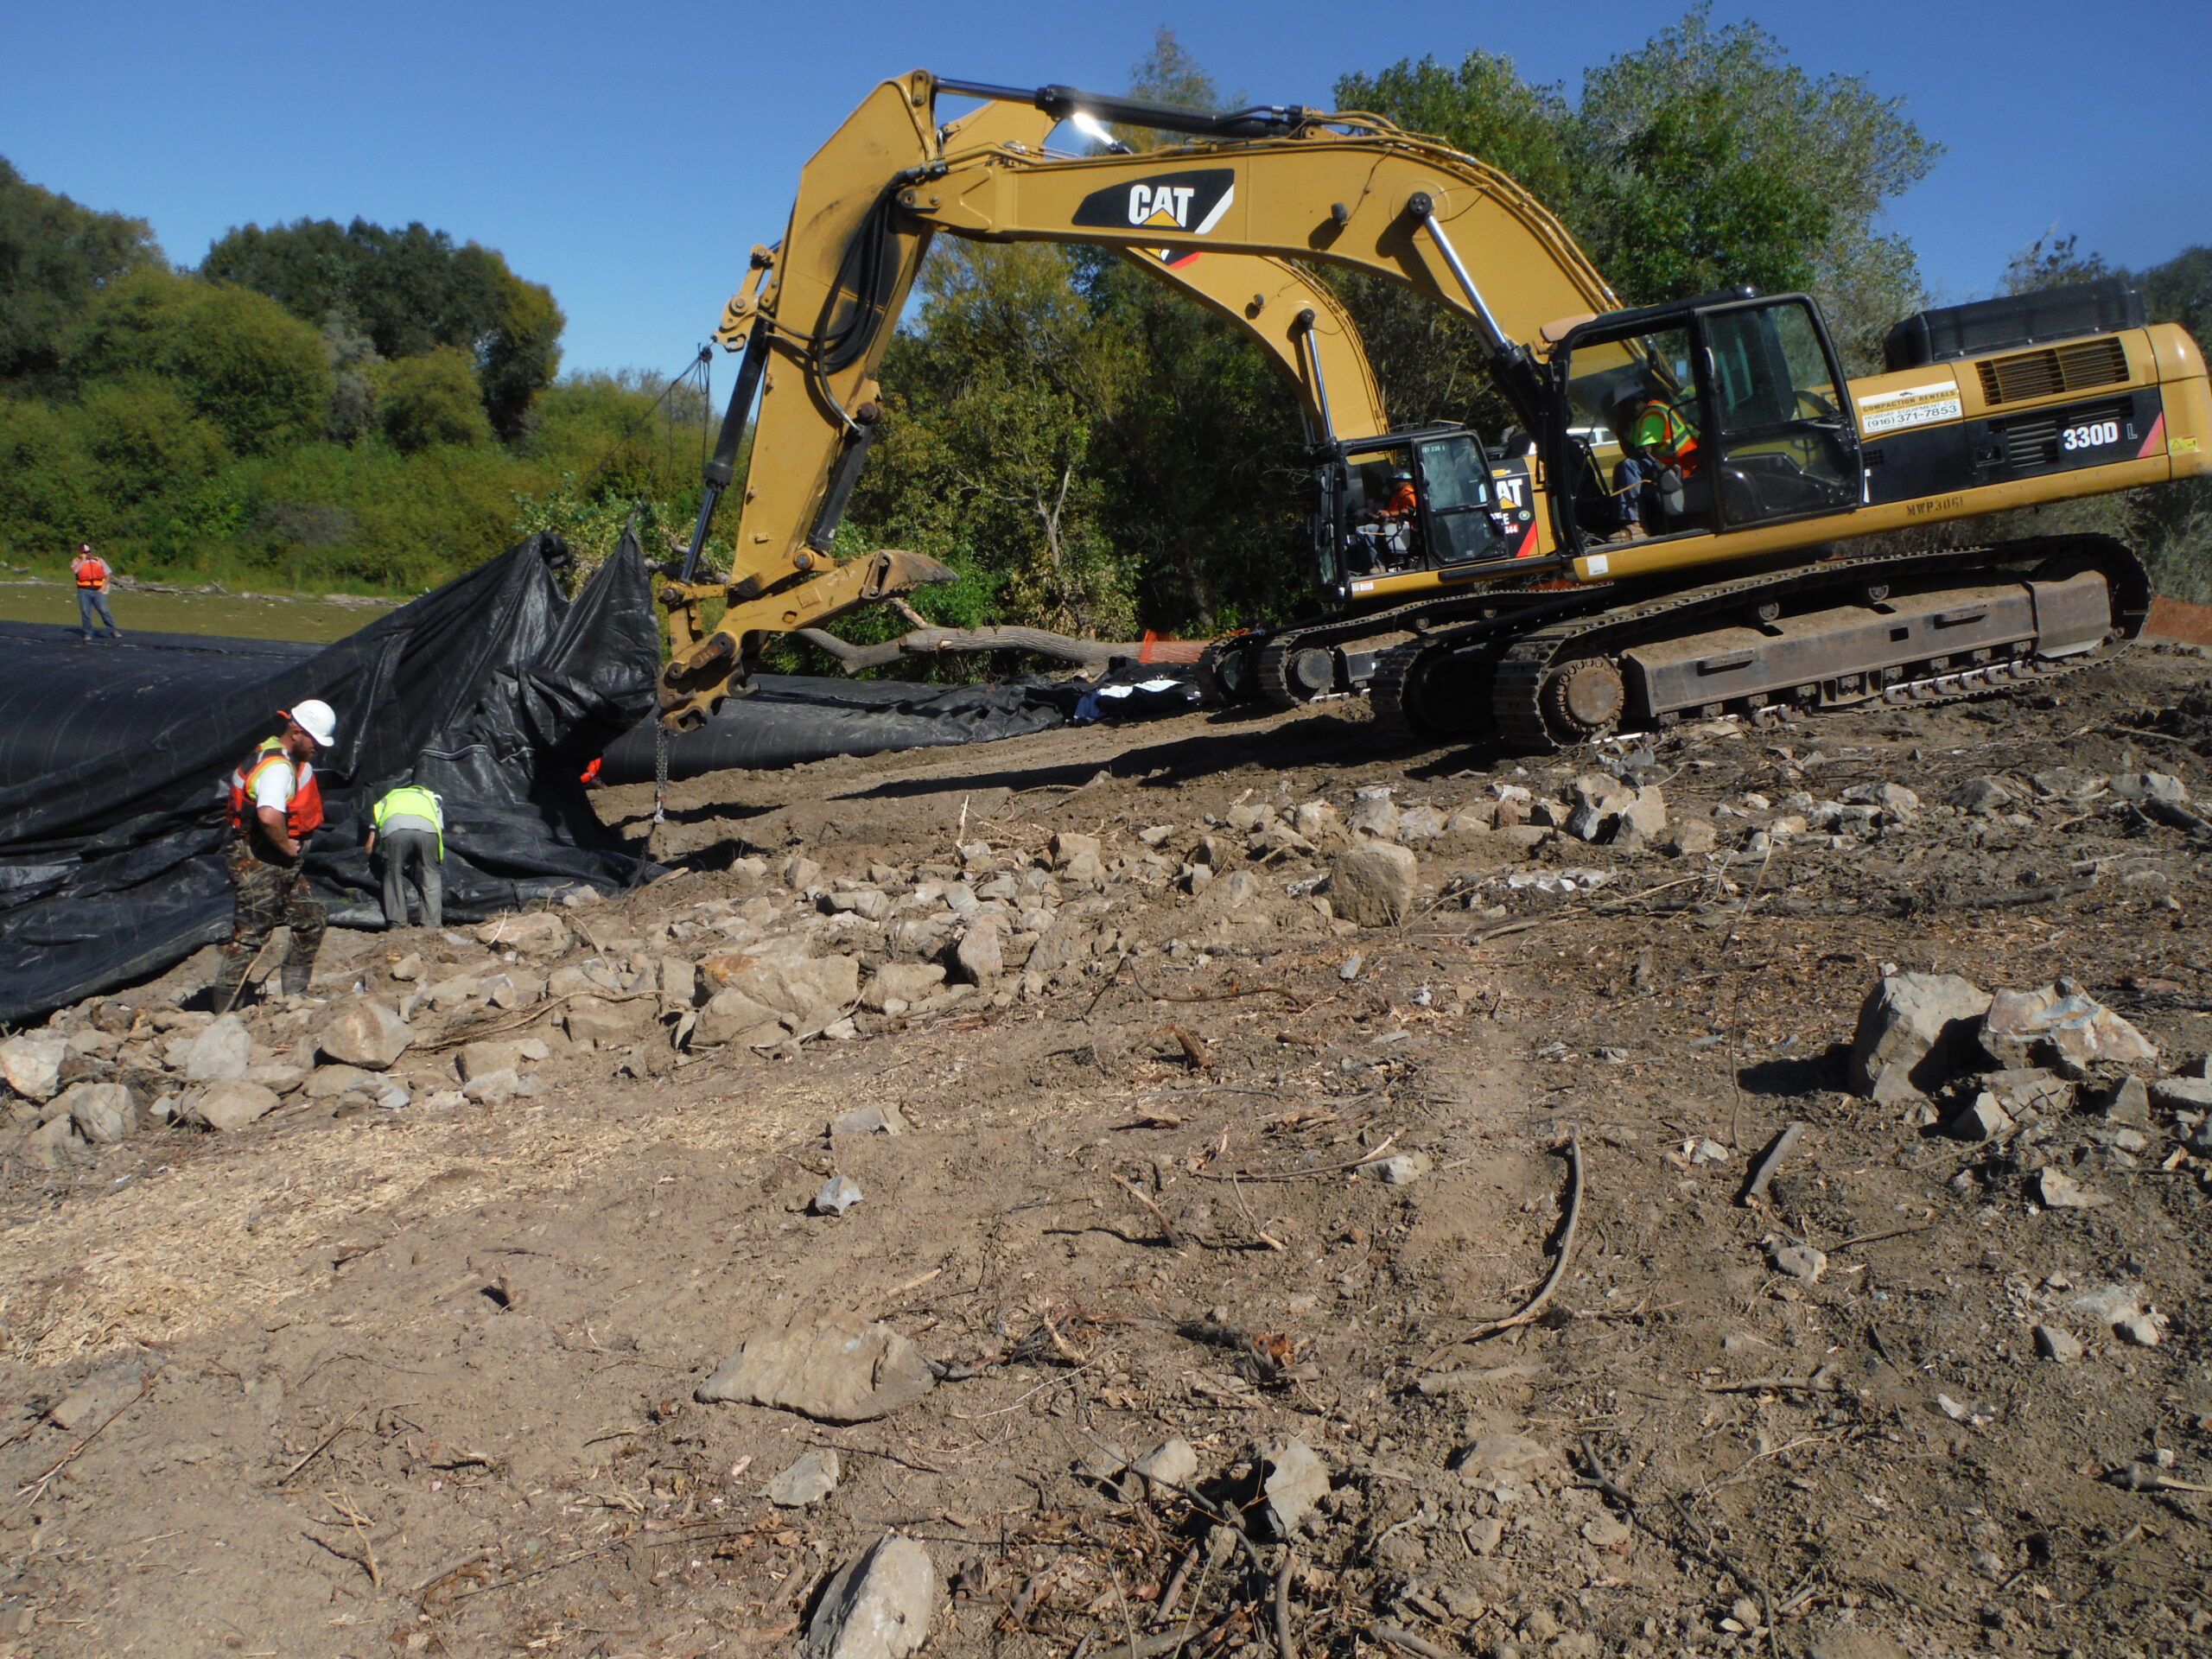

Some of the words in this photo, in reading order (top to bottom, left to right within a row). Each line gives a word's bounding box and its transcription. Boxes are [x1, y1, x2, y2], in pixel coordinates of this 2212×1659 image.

[1128, 184, 1194, 227] CAT
[1863, 398, 1916, 412] COMPACTION
[1919, 390, 1956, 402] RENTALS
[1867, 416, 1895, 429] (916)
[1897, 404, 1957, 423] 371-7853
[2063, 421, 2119, 450] 330D
[2126, 423, 2139, 440] L
